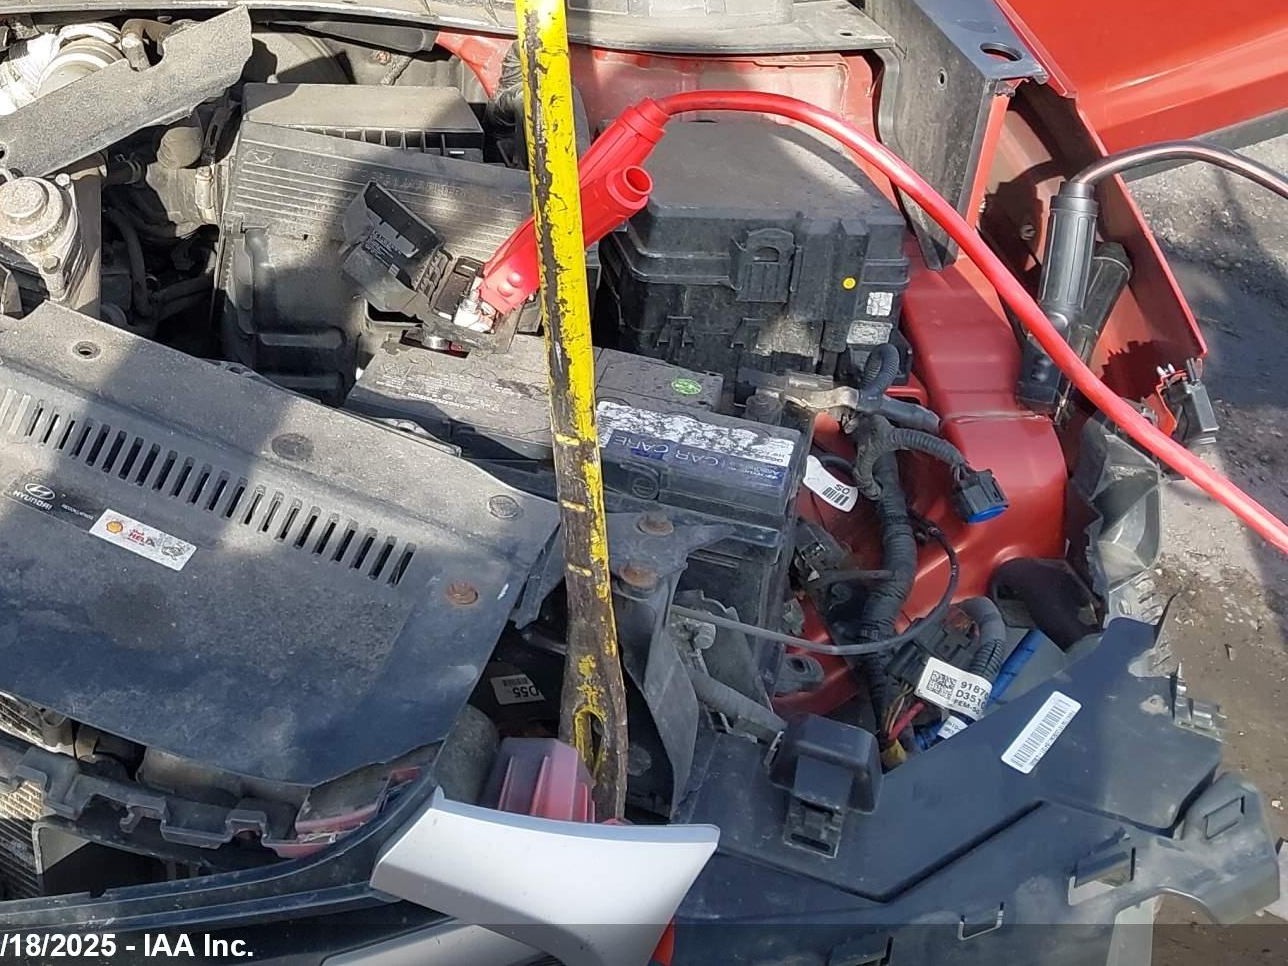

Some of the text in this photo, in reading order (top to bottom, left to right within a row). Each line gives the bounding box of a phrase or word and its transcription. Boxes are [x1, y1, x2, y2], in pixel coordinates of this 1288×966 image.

[614, 433, 719, 468] CAR CARE
[12, 490, 53, 511] HYUNDAI
